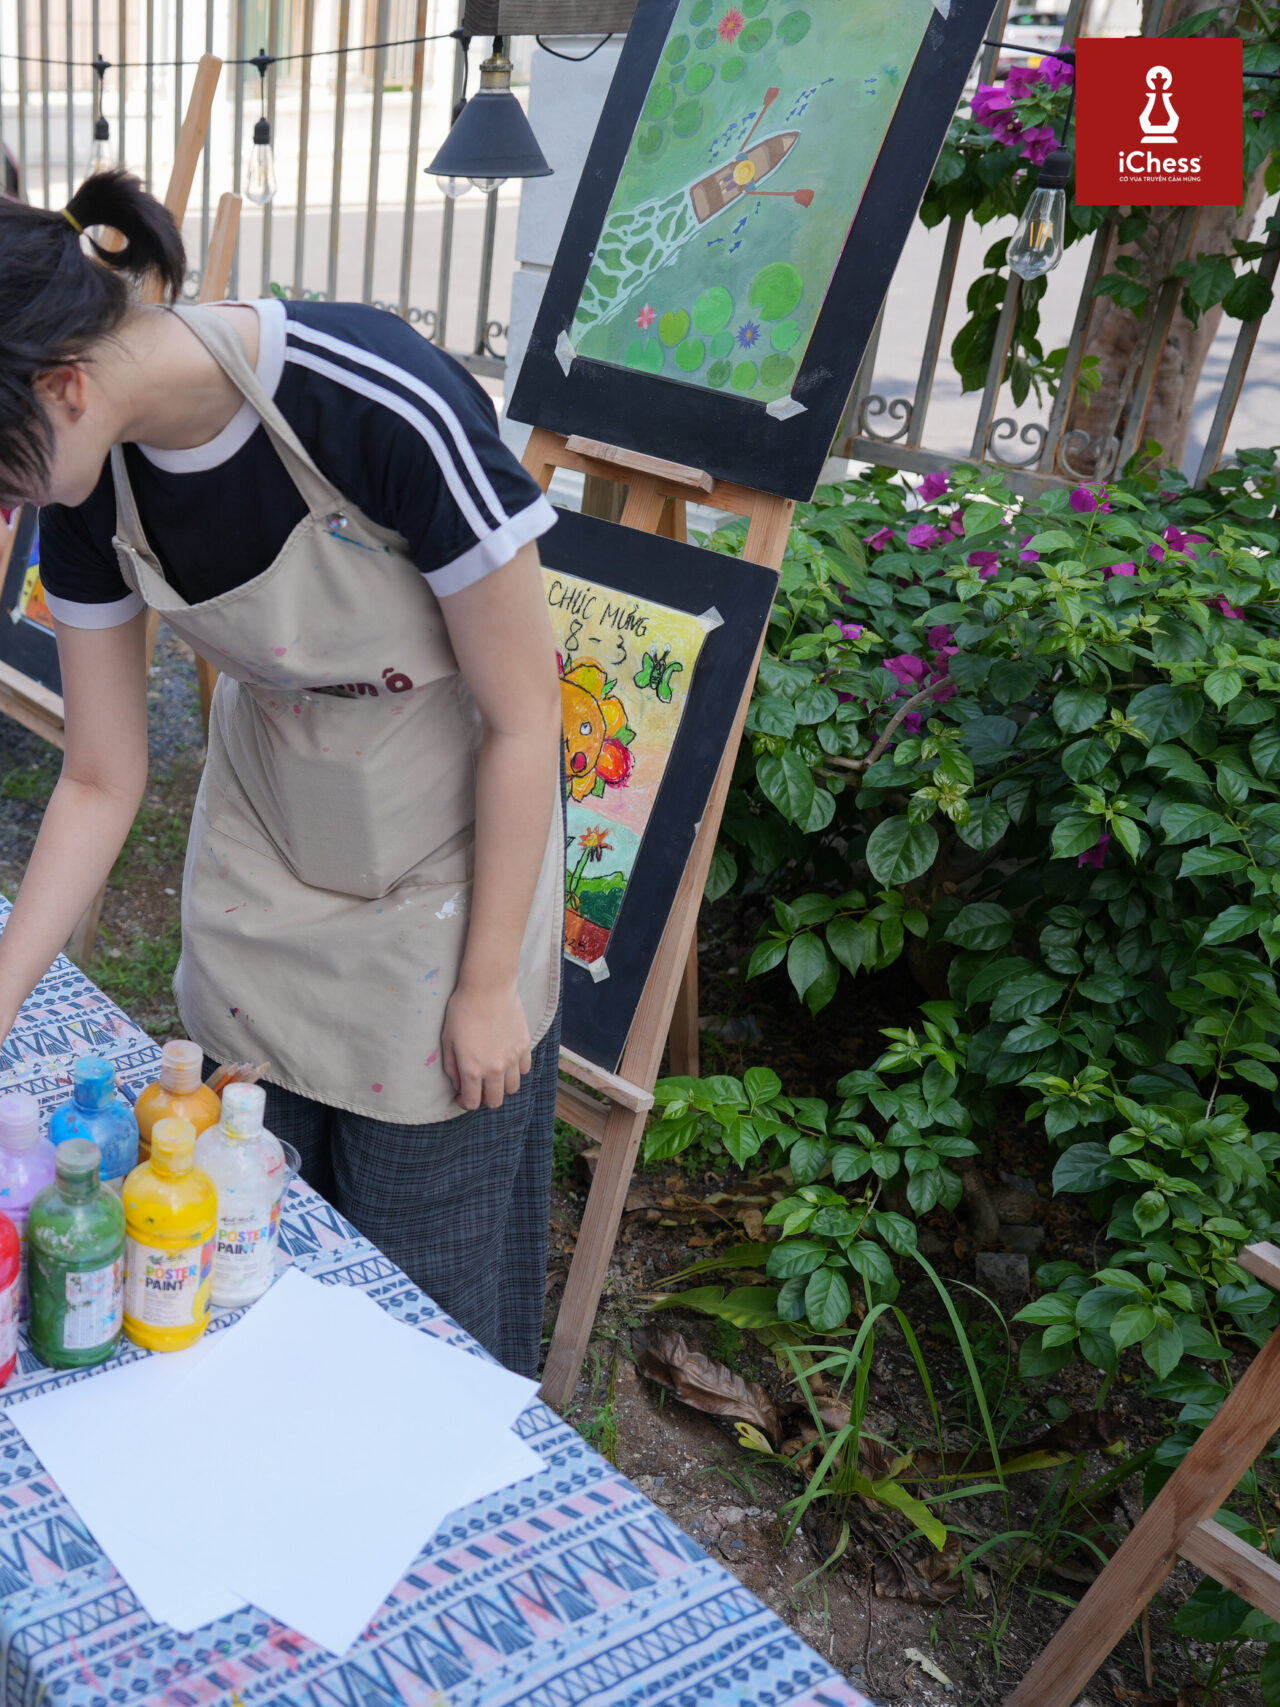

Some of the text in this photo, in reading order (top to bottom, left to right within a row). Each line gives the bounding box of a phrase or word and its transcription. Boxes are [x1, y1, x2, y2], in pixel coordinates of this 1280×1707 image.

[218, 1226, 268, 1242] POSTER
[217, 1242, 256, 1254] PAINT
[145, 1264, 198, 1280] POSTER
[145, 1277, 184, 1291] PAINT
